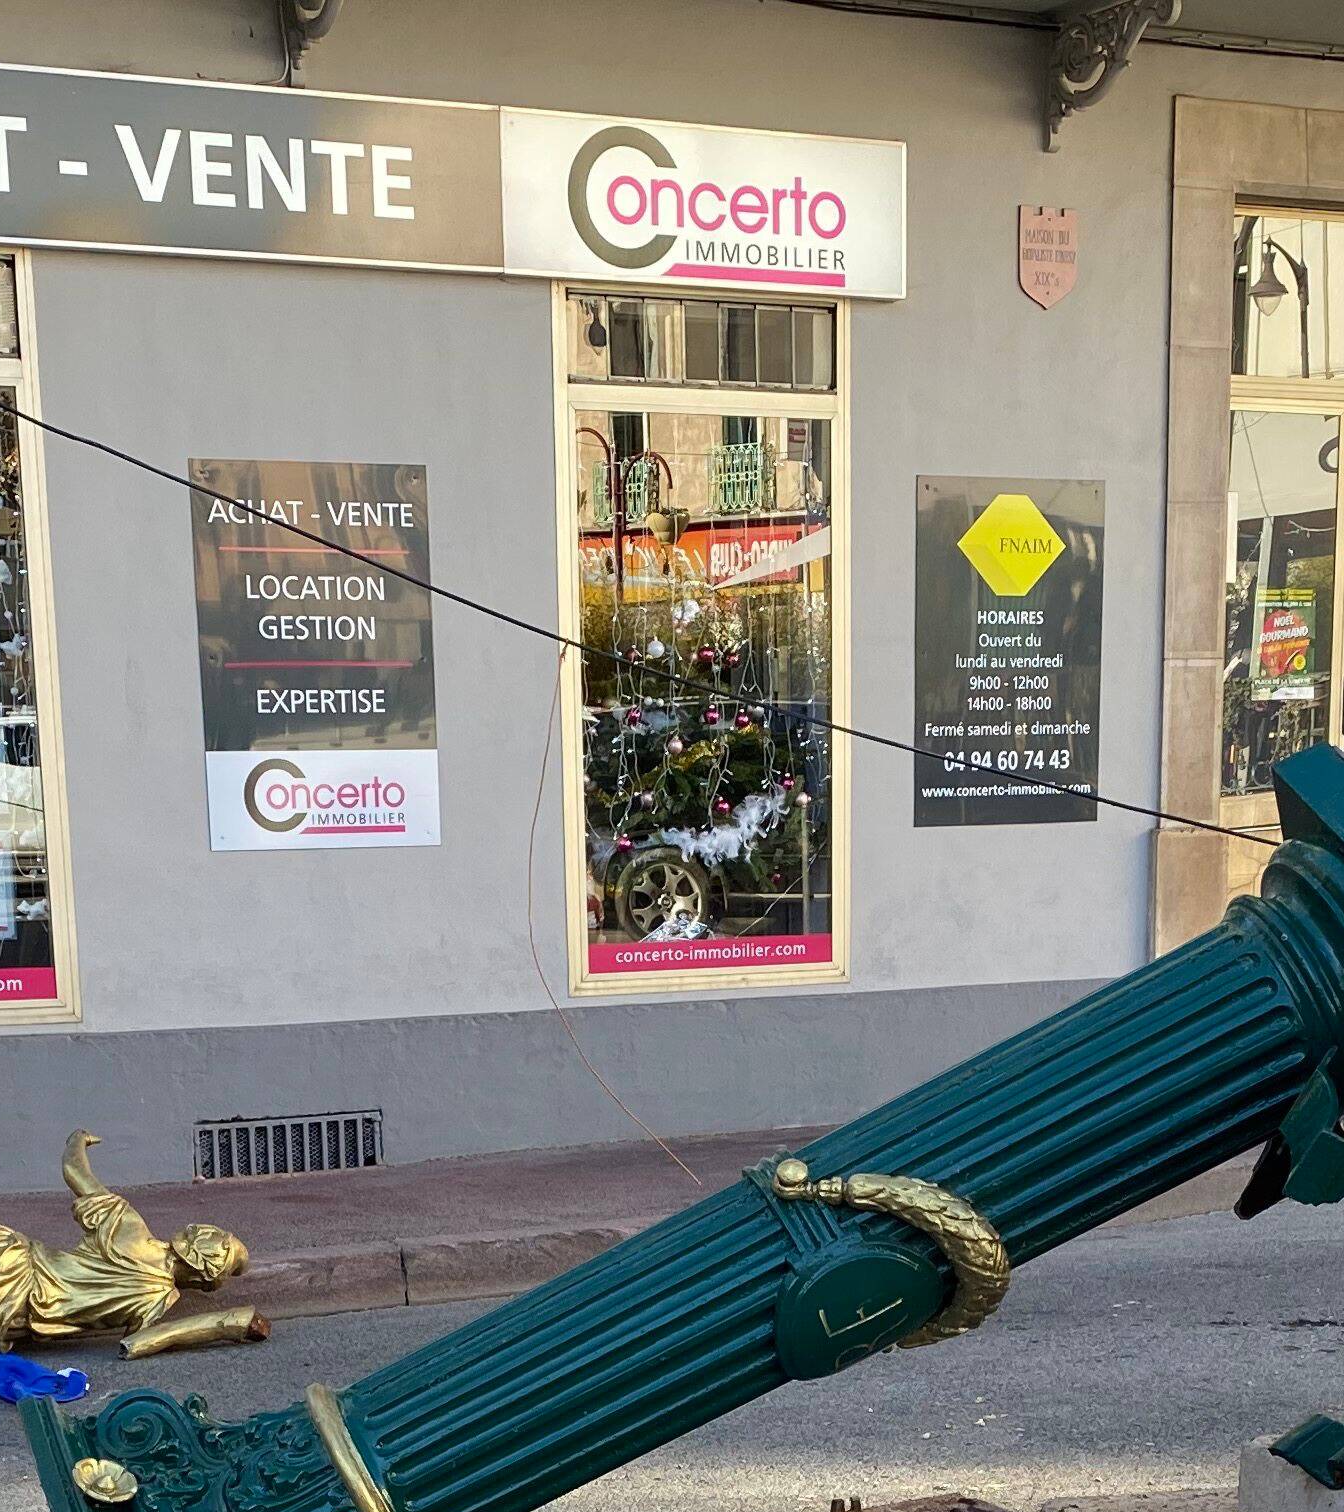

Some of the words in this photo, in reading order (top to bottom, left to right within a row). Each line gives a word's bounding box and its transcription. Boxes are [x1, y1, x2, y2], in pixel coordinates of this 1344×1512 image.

[58, 159, 88, 176] -
[114, 124, 416, 221] VENTE
[567, 125, 847, 270] Concerto
[685, 239, 847, 271] IMMOBILIER
[207, 498, 305, 526] ACHAT
[326, 501, 414, 528] VENTE
[999, 537, 1053, 555] FNAIM
[245, 574, 386, 602] LOCATION
[258, 615, 377, 641] GESTION
[977, 610, 1044, 626] HORAIRES
[978, 633, 1023, 648] Ouvert
[1026, 633, 1042, 648] du
[955, 653, 987, 669] lundi
[990, 656, 1007, 669] au
[1010, 653, 1064, 669] vendredi
[969, 676, 1001, 691] 9h00
[1012, 676, 1049, 691] 12h00
[256, 688, 386, 714] EXPERTISE
[967, 697, 1004, 711] 14h00
[1015, 696, 1052, 711] 18h00
[924, 721, 964, 738] Fermé
[967, 721, 1012, 737] samedi
[1015, 723, 1028, 736] et
[1031, 720, 1091, 736] dimanche
[970, 751, 993, 772] 94
[997, 750, 1019, 771] 60
[1023, 750, 1045, 771] 74
[1048, 749, 1070, 770] 43
[244, 757, 406, 833] Concerto
[921, 782, 1092, 799] www.concerto-immobilicom
[311, 812, 406, 826] IMMOBILIER
[615, 942, 806, 963] concerto-immobilier.com
